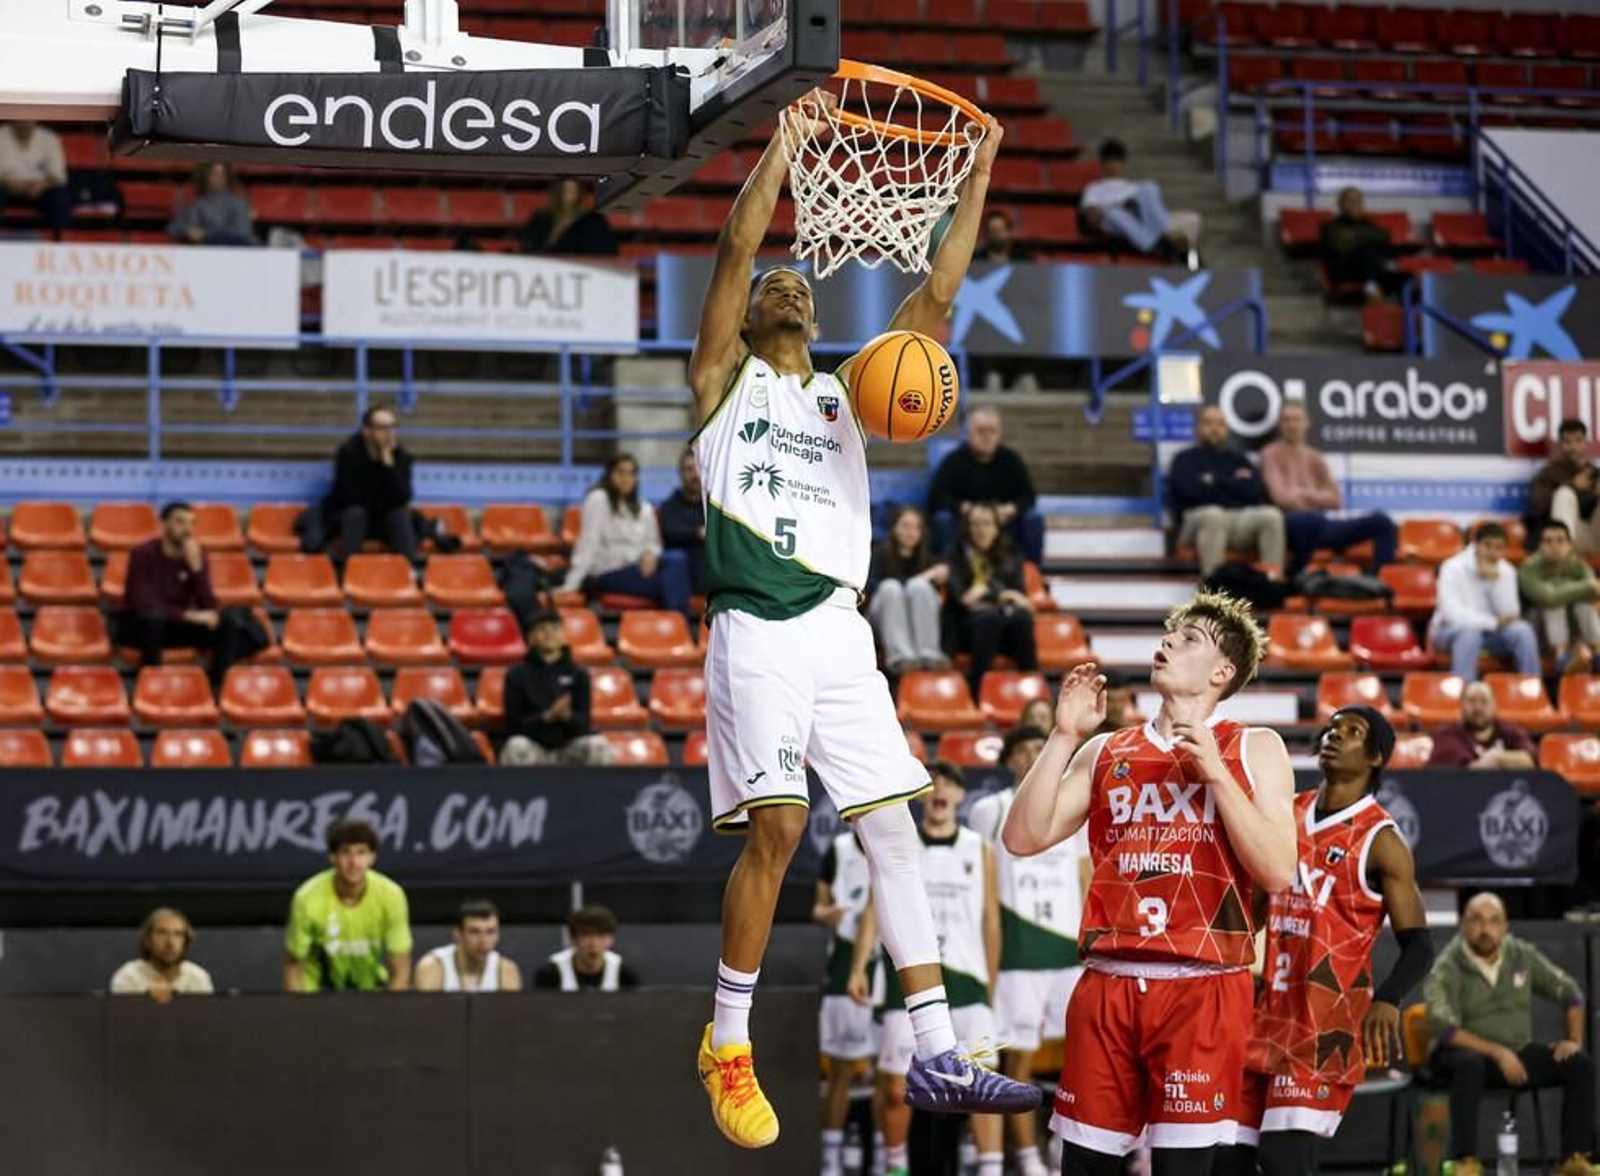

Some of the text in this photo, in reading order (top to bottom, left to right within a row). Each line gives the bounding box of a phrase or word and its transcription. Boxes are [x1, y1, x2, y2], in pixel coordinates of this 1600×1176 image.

[264, 81, 600, 154] endesa
[34, 247, 175, 277] RAMON
[11, 279, 197, 312] ROQUETA
[1512, 373, 1600, 444] CLI
[771, 422, 843, 454] Fundación
[771, 434, 823, 465] Unicaja
[774, 517, 797, 556] 5
[1107, 783, 1217, 825] BAXI
[1106, 826, 1215, 844] CLIMATIZACIÓN
[1484, 815, 1545, 838] BAXI
[1119, 852, 1194, 878] MANRESA
[1138, 896, 1168, 937] 3
[1272, 952, 1291, 992] 2
